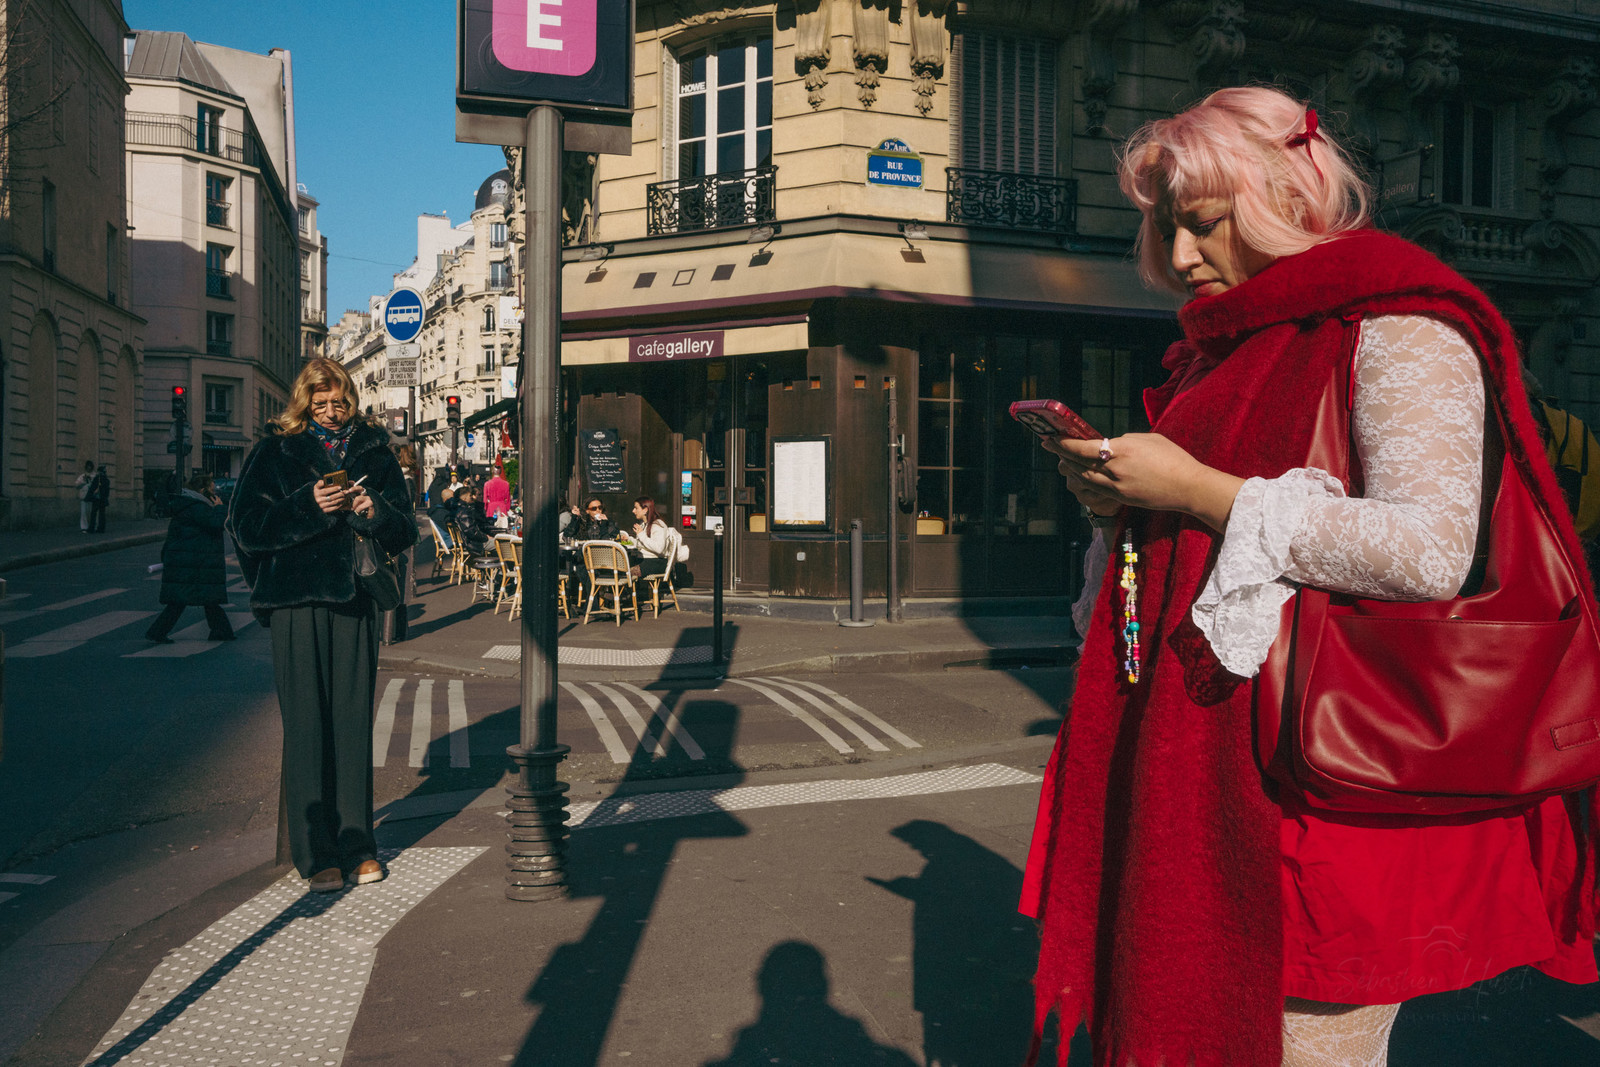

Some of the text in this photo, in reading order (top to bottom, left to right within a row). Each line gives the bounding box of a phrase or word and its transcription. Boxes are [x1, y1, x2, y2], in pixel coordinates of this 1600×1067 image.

[527, 0, 563, 51] E
[887, 160, 903, 170] RUE
[868, 170, 922, 183] DE PROVENCE
[1384, 182, 1417, 200] gallery
